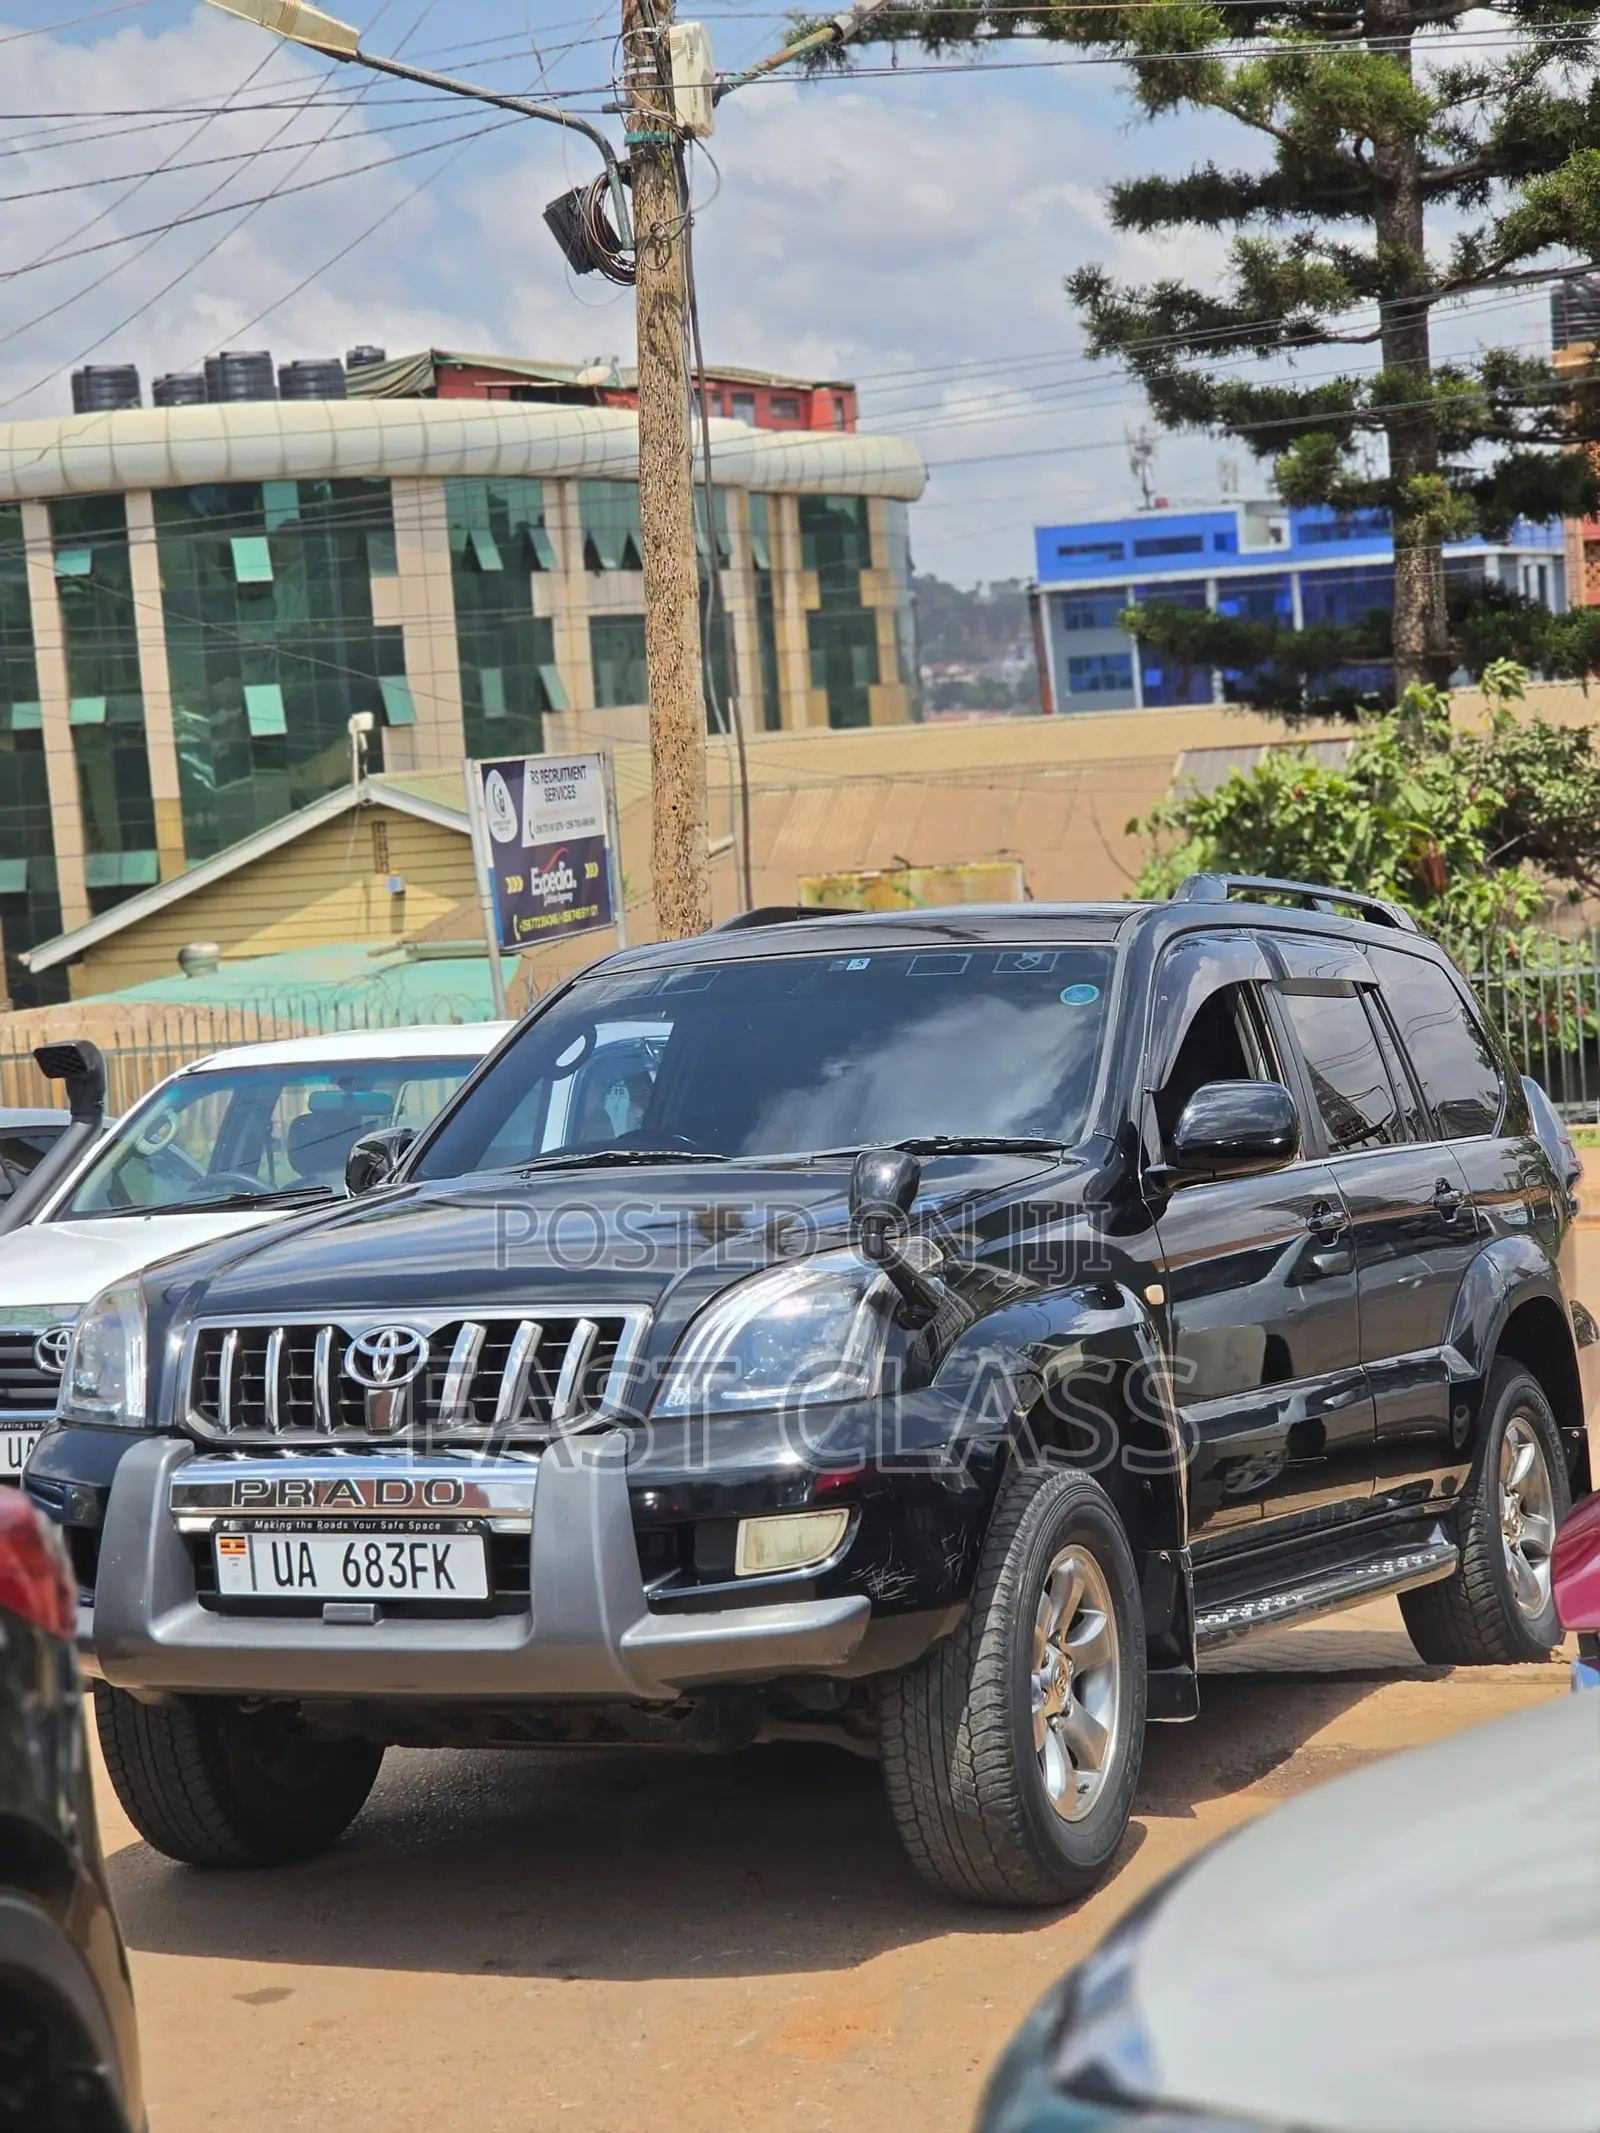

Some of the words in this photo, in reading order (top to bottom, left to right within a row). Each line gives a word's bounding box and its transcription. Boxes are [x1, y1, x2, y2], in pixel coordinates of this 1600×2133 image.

[540, 765, 587, 784] RECRUITMENT
[544, 785, 577, 802] SERVICES
[231, 1478, 466, 1508] PRADO
[254, 1519, 293, 1532] Making
[295, 1519, 313, 1529] the
[316, 1520, 349, 1530] Roads
[352, 1520, 377, 1530] Your
[380, 1520, 405, 1530] Safe
[408, 1521, 441, 1532] Space
[271, 1541, 318, 1587] UA
[342, 1542, 456, 1590] 683FK
